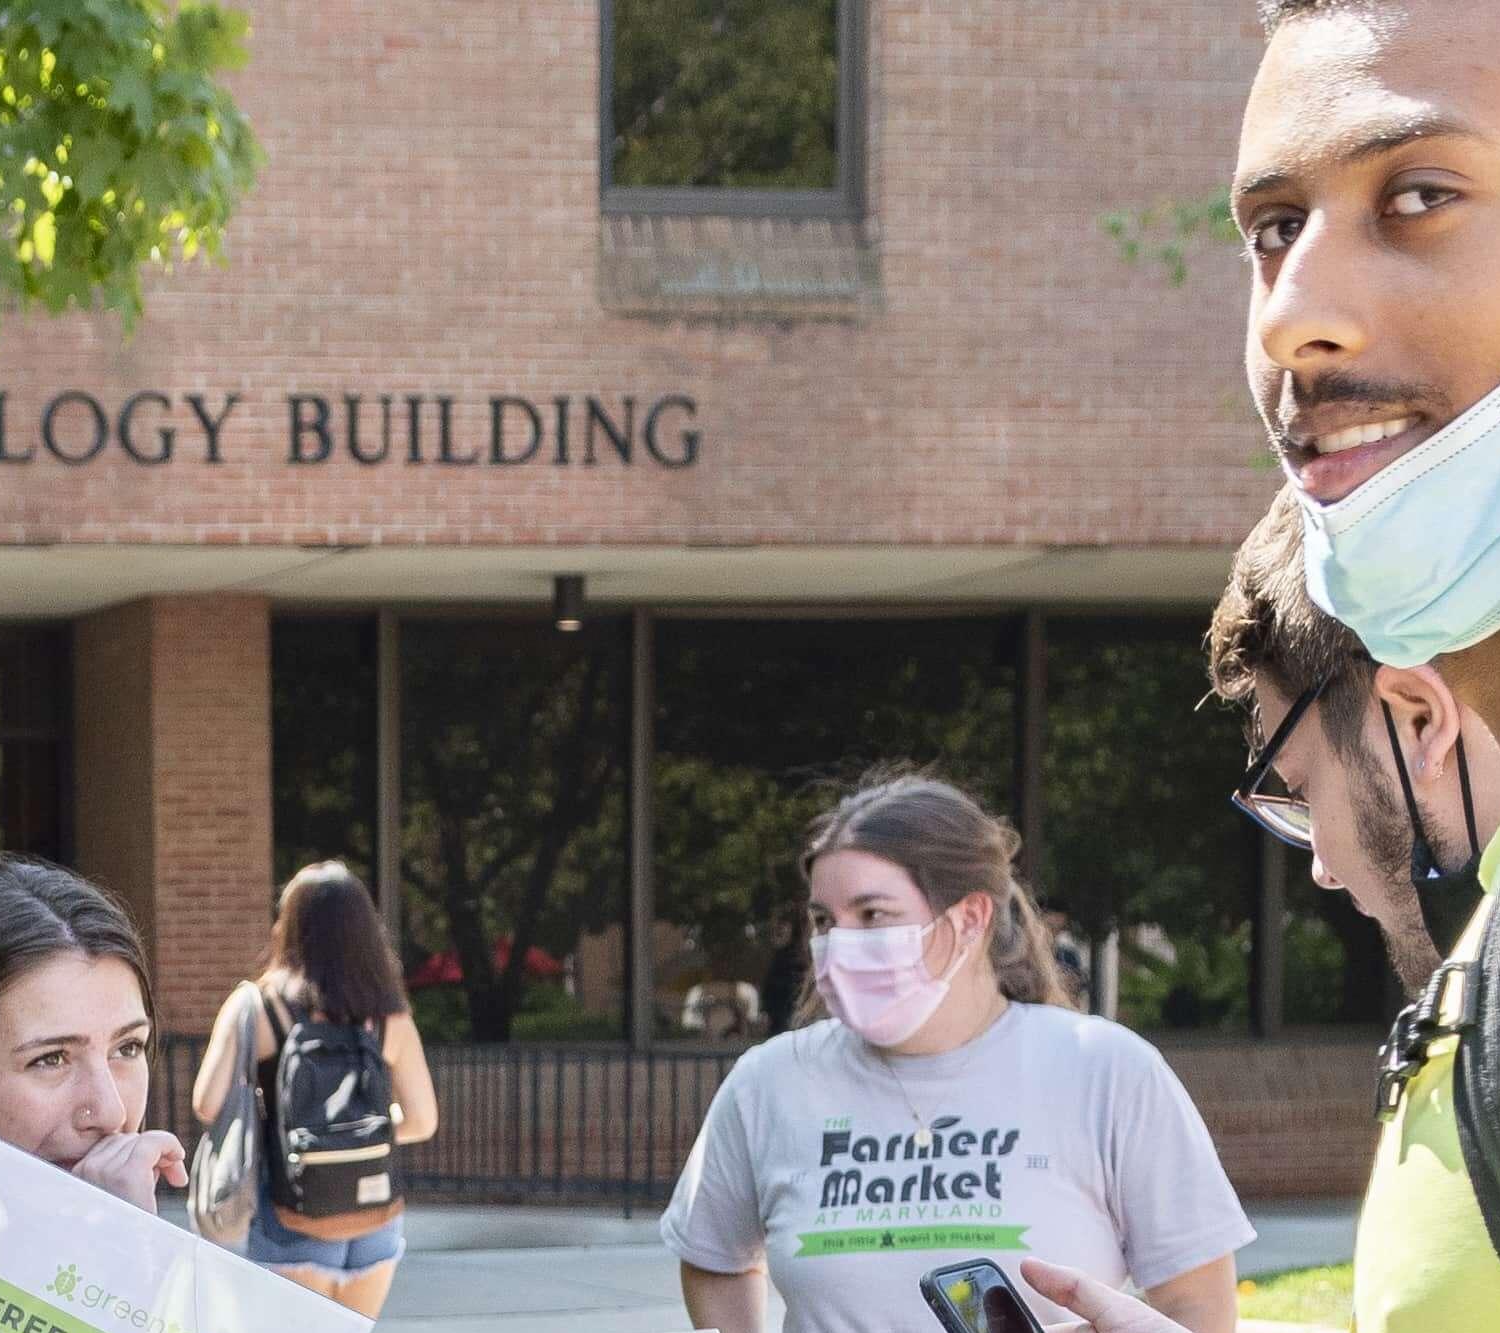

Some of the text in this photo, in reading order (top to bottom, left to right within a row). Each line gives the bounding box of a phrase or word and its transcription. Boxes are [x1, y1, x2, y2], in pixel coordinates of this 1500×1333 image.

[287, 394, 704, 472] BUILDING
[823, 1117, 852, 1130] THE
[819, 1127, 1020, 1168] Farmers
[818, 1162, 1005, 1208] Market
[814, 1203, 1005, 1226] AT MARYLAND
[898, 1233, 929, 1246] went
[933, 1231, 946, 1245] to
[950, 1230, 996, 1244] market
